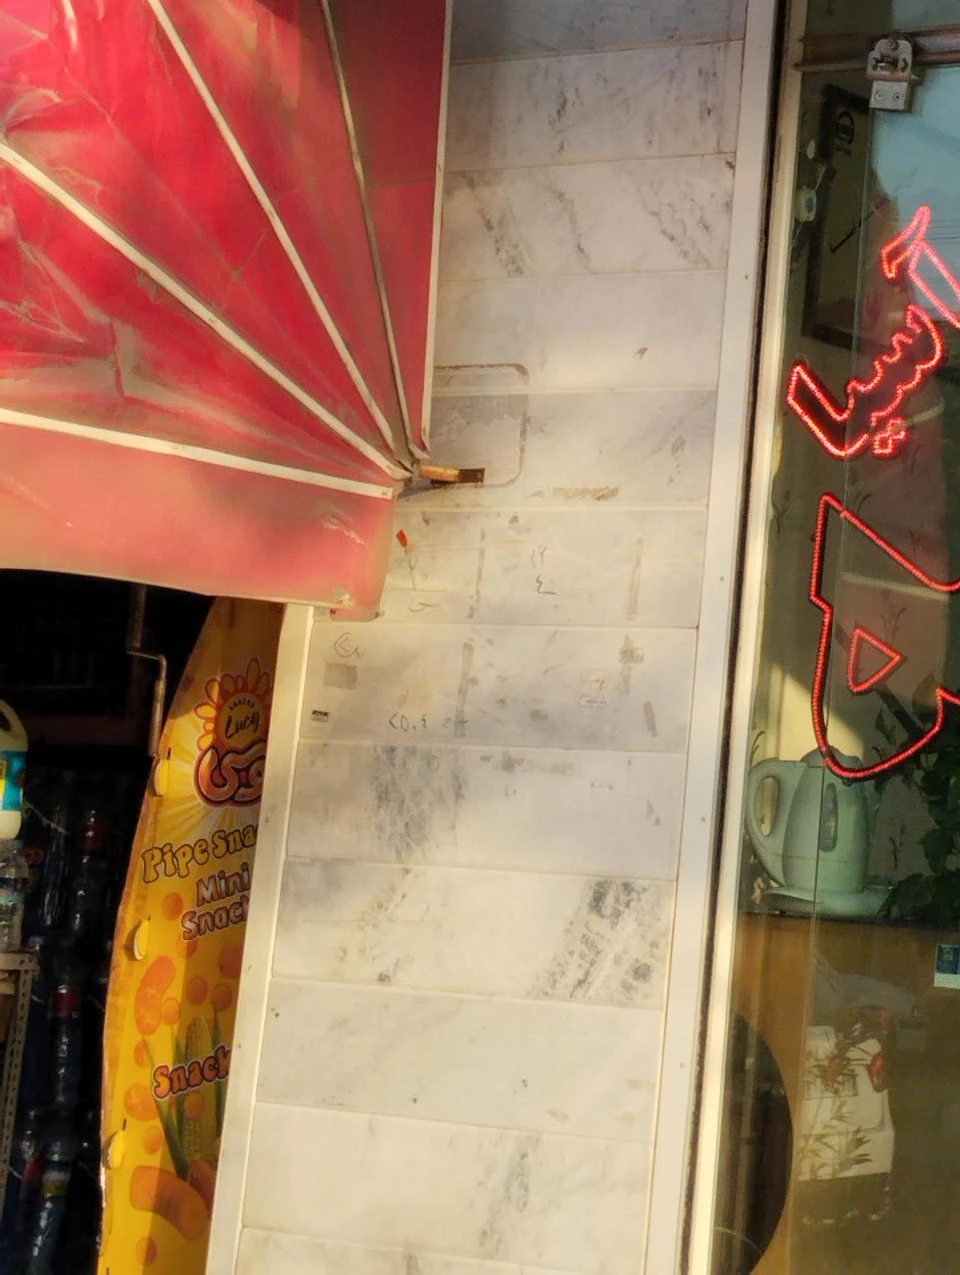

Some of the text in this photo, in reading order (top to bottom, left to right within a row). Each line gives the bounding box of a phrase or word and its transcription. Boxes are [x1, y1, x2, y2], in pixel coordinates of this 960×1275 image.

[141, 824, 258, 884] Pipe Sna
[196, 861, 251, 907] Mini
